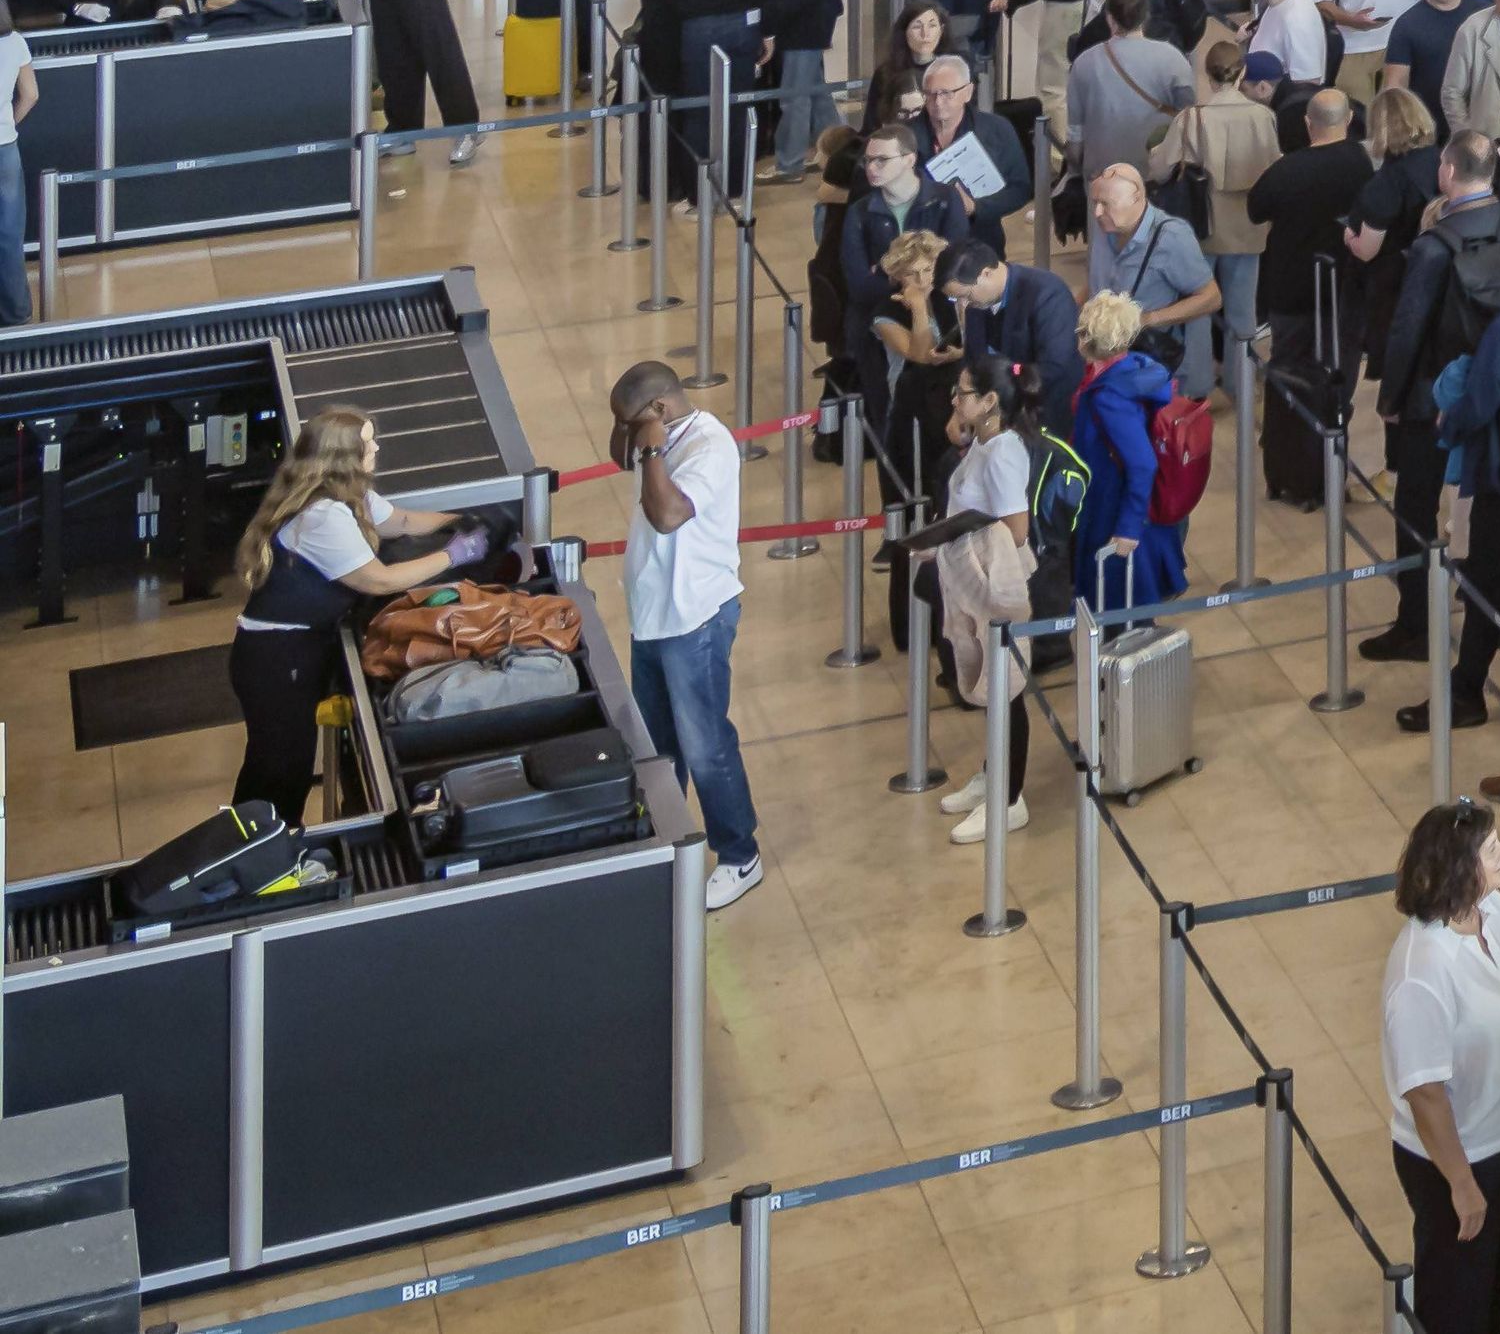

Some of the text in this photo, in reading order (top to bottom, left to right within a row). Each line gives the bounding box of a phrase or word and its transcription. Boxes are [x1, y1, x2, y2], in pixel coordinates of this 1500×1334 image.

[297, 143, 317, 154] BER
[176, 159, 196, 170] BER
[783, 413, 812, 429] STOP
[834, 518, 868, 531] STOP
[1352, 566, 1375, 580] BER
[1206, 595, 1230, 607] BER
[1307, 888, 1335, 904] BER
[1161, 1104, 1191, 1124] BER
[959, 1149, 991, 1170] BER
[626, 1223, 661, 1246] BER
[401, 1279, 437, 1302] BER
